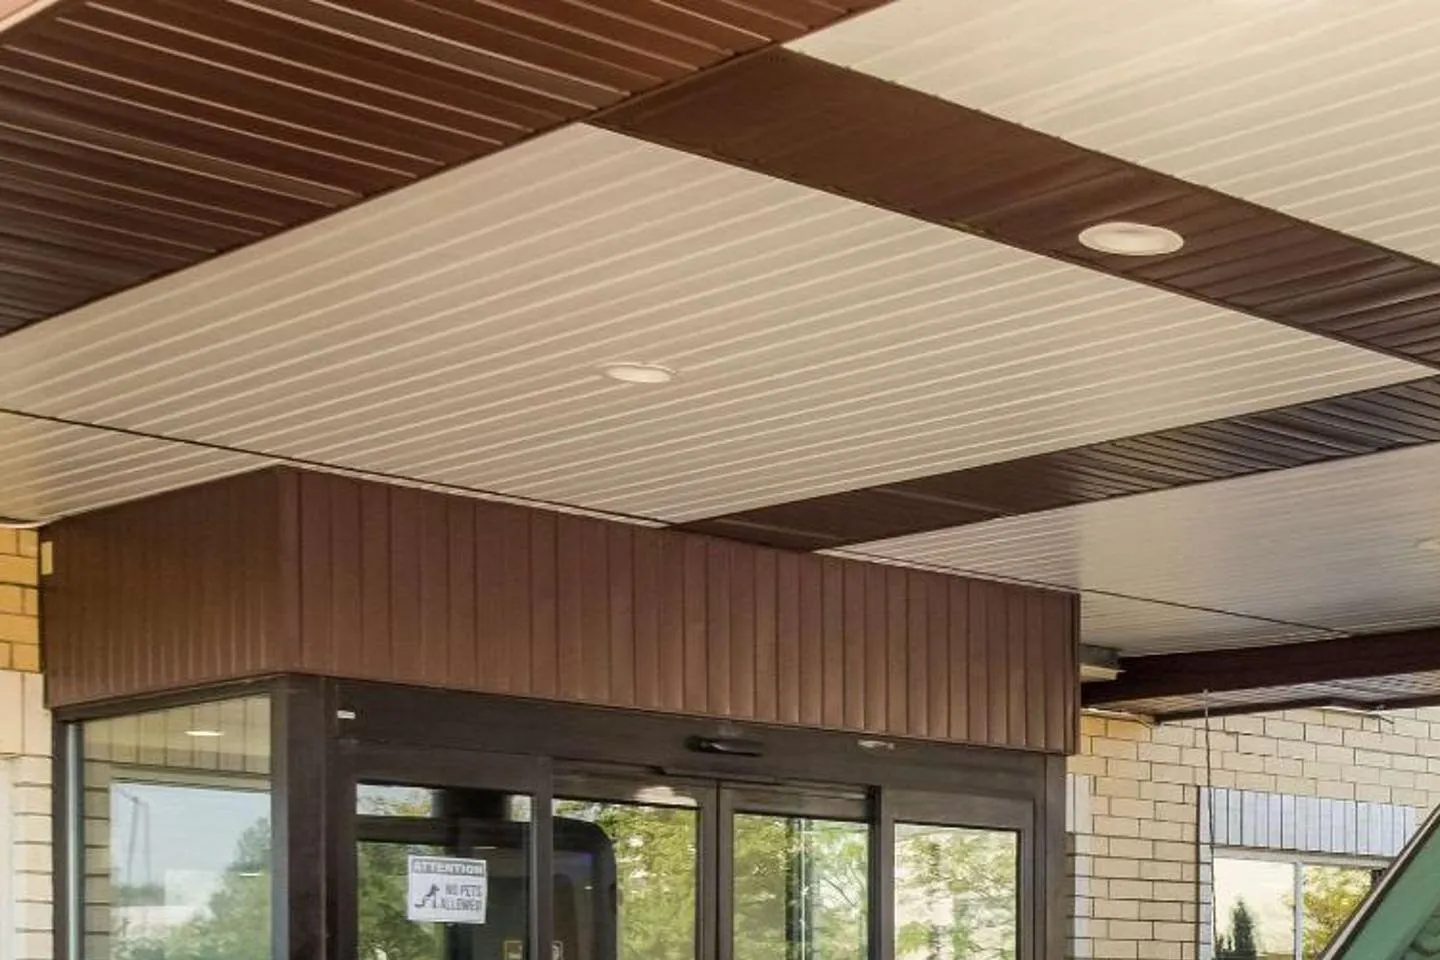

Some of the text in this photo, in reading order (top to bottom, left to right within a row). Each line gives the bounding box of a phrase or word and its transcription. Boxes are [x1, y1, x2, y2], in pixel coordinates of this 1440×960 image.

[413, 860, 483, 875] ATTENTION
[445, 884, 482, 897] NO PETS
[440, 897, 482, 911] ALLOWED
